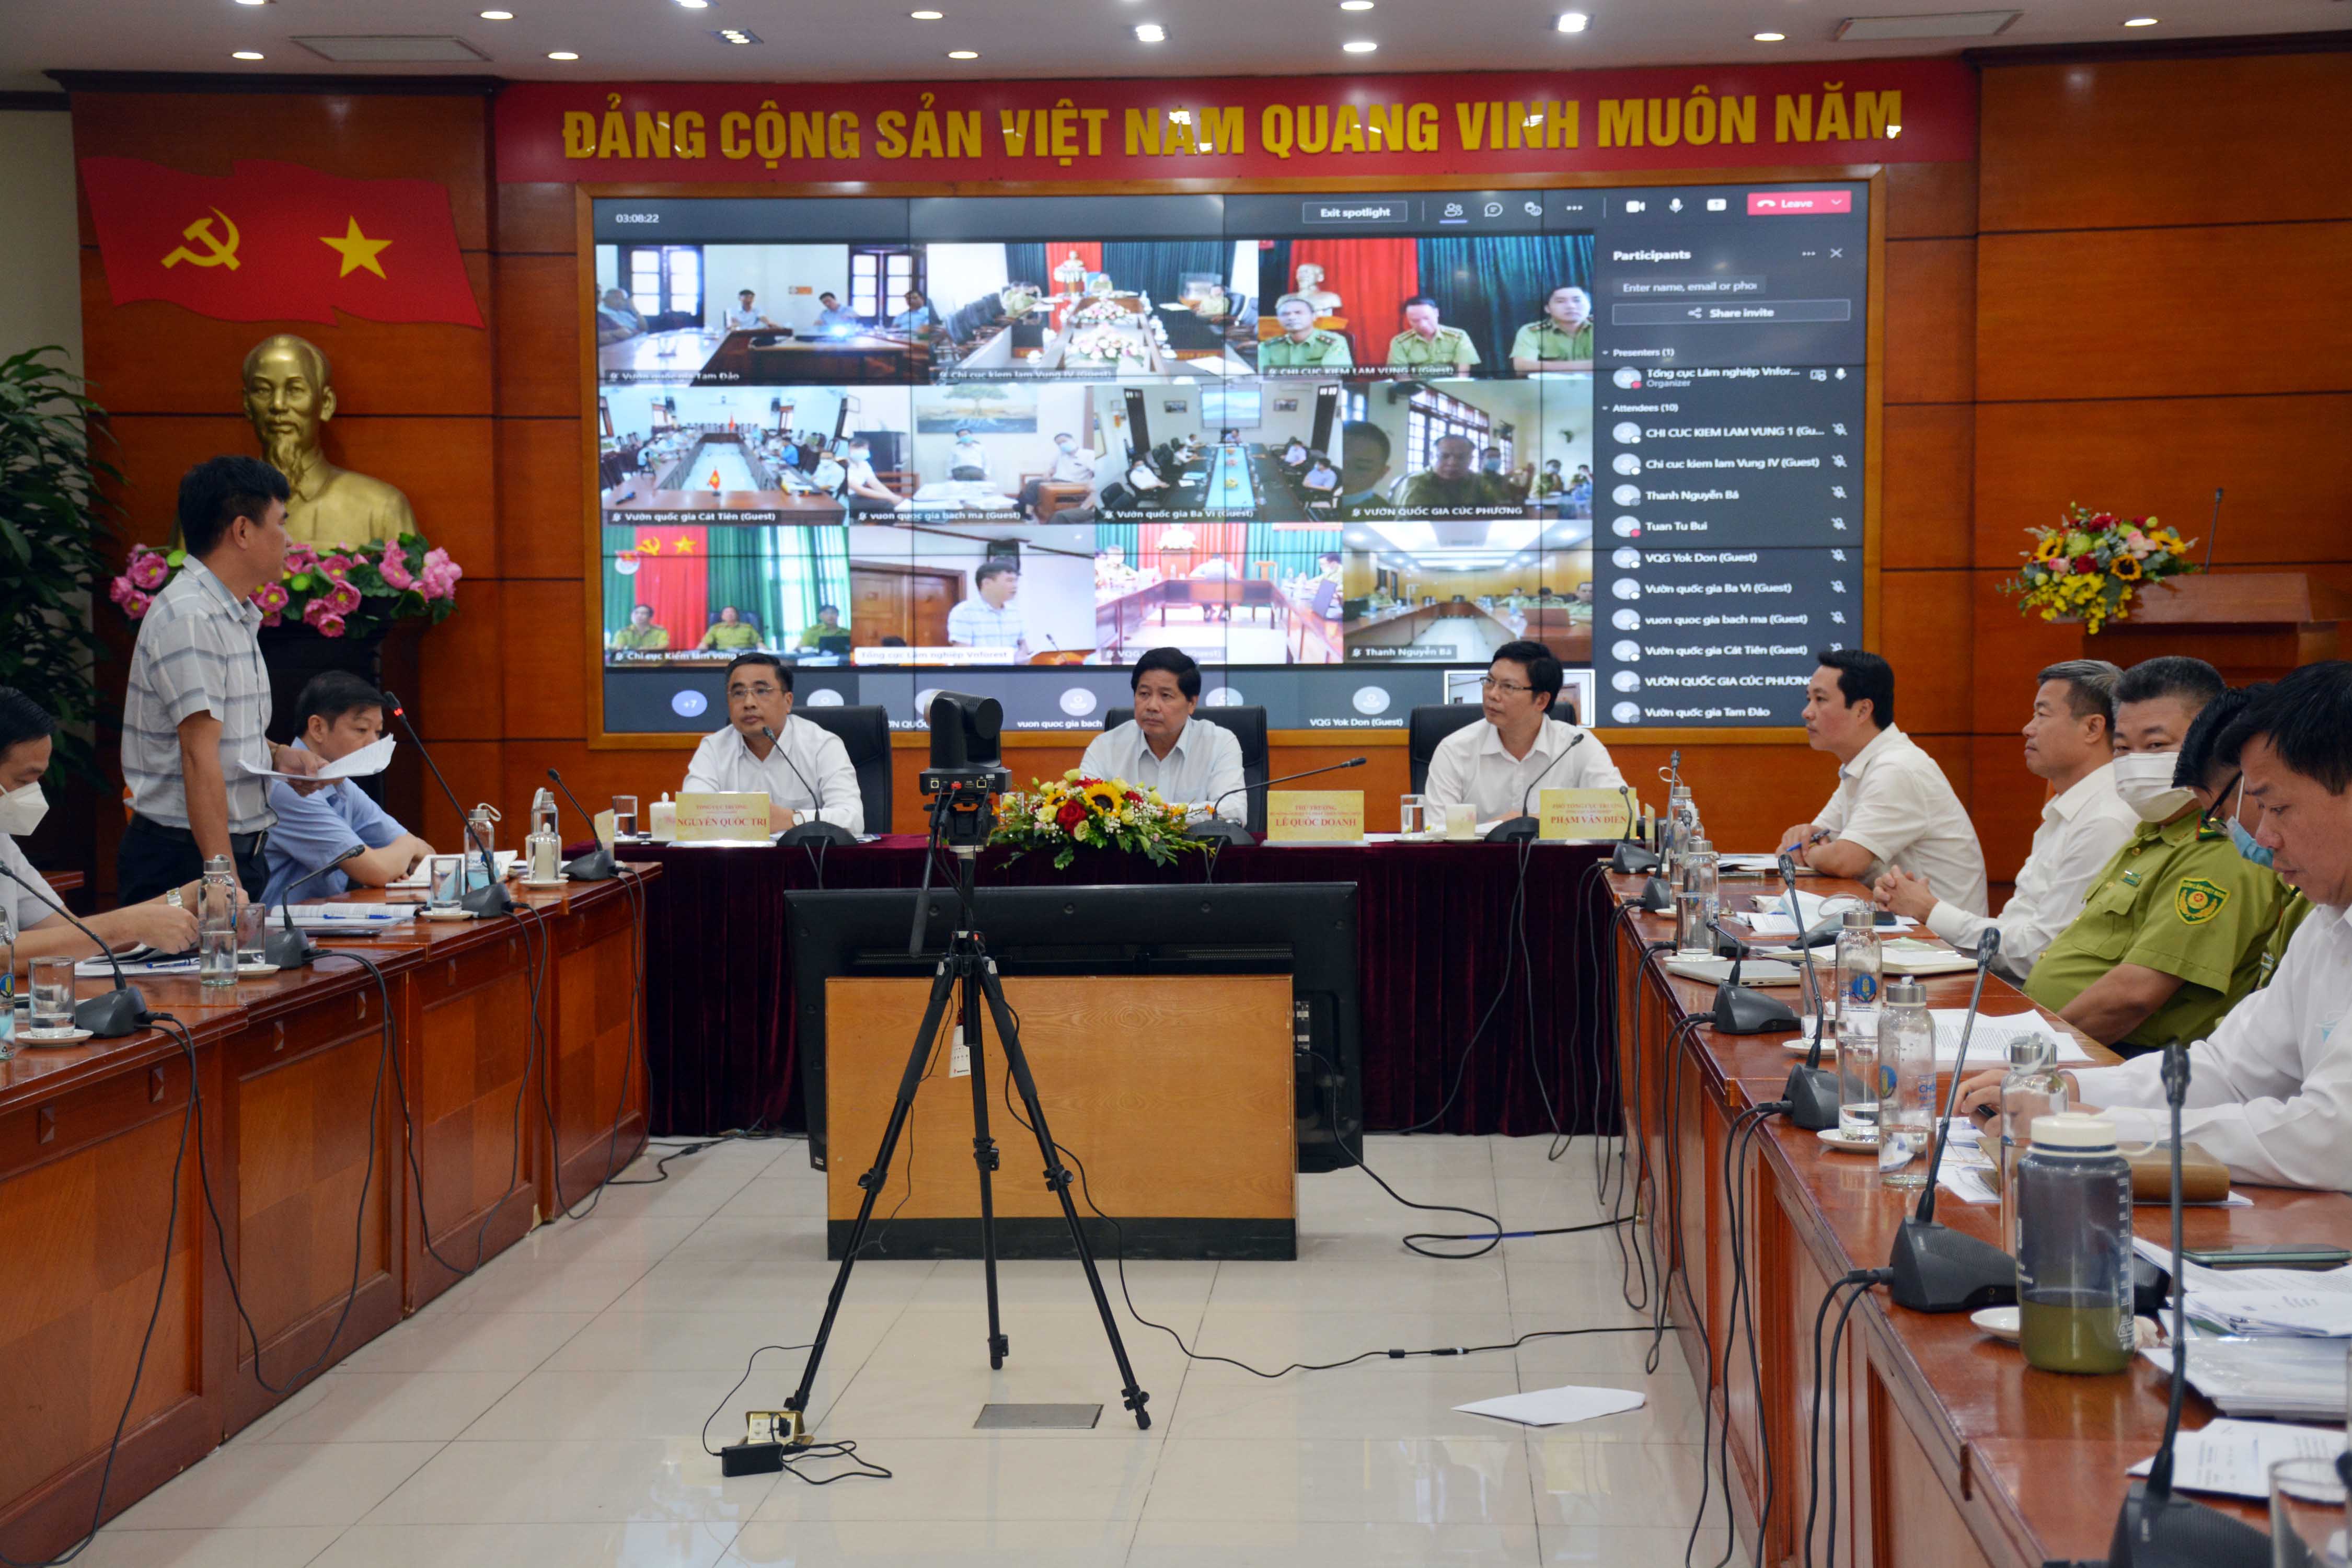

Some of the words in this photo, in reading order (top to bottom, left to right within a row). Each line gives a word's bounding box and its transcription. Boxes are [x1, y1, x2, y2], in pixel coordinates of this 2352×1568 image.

[562, 92, 706, 159] ĐẢNG
[720, 100, 860, 169] CỘNG
[875, 92, 982, 158] SẢN
[1000, 98, 1109, 166] VIỆT
[1125, 106, 1245, 156] NAM
[1262, 102, 1438, 158] QUANG
[1456, 100, 1579, 150] VINH
[1598, 85, 1757, 148] MUÔN
[1775, 82, 1902, 143] NĂM
[1781, 199, 1812, 209] Leave
[1320, 208, 1340, 217] Exit
[1343, 207, 1390, 219] spotlight
[616, 214, 660, 224] 03:08:22
[1613, 250, 1691, 262] Participants
[1623, 283, 1651, 292] Enter
[1653, 284, 1685, 293] name,
[1688, 282, 1716, 291] email
[1710, 309, 1741, 318] Share
[1743, 308, 1774, 317] invite
[1613, 348, 1660, 356] Presenters
[1662, 348, 1675, 357] (1)
[697, 372, 717, 381] Tam
[719, 370, 739, 381] Đảo
[1646, 369, 1675, 379] Tổng
[1677, 370, 1695, 379] cục
[1697, 367, 1720, 378] Lâm
[1722, 367, 1759, 378] nghiệp
[1646, 379, 1691, 388] Organizer
[1612, 404, 1658, 412] Attendees
[1661, 403, 1678, 413] (10)
[1645, 429, 1666, 437] CHI
[1668, 428, 1692, 437] CUC
[1694, 428, 1722, 437] KIEM
[1724, 428, 1747, 436] LAM
[1750, 427, 1786, 436] VUNG
[1645, 460, 1664, 468] Chi
[1688, 459, 1713, 468] kiem
[1715, 459, 1735, 468] lam
[1737, 459, 1766, 470] Vung
[1768, 458, 1780, 468] IV
[1781, 457, 1819, 468] (Guest)
[1645, 491, 1678, 500] Thanh
[1681, 490, 1723, 502] Nguyễn
[897, 512, 920, 522] quoc
[925, 512, 941, 521] gia
[942, 511, 966, 520] bach
[986, 511, 1021, 520] (Guest)
[1117, 510, 1144, 518] Vườn
[1146, 509, 1170, 521] quốc
[1172, 510, 1188, 521] gia
[1190, 510, 1203, 518] Ba
[1218, 509, 1253, 519] (Guest)
[1364, 507, 1396, 516] VƯỜN
[1398, 505, 1428, 517] QUỐC
[1475, 505, 1522, 515] PHƯƠNG
[654, 512, 678, 522] quốc
[681, 513, 696, 522] gia
[698, 512, 716, 521] Cát
[718, 512, 738, 521] Tiên
[741, 512, 776, 522] (Guest)
[1645, 522, 1672, 531] Tuan
[1674, 522, 1688, 531] Tu
[1690, 522, 1708, 531] Bui
[1645, 554, 1670, 563] VQG
[1673, 553, 1692, 562] Yok
[1694, 554, 1717, 562] Don
[1719, 552, 1757, 563] (Guest)
[1645, 584, 1674, 593] Vườn
[1677, 583, 1703, 595] quốc
[1705, 584, 1723, 595] gia
[1725, 584, 1738, 593] Ba
[1754, 583, 1792, 594] (Guest)
[1674, 616, 1701, 627] quoc
[1703, 615, 1720, 626] gia
[1722, 615, 1749, 624] bach
[1769, 614, 1808, 625] (Guest)
[1365, 648, 1396, 656] Thanh
[1398, 646, 1437, 658] Nguyễn
[1645, 646, 1674, 656] Vườn
[1676, 645, 1703, 658] quốc
[1705, 646, 1722, 657] gia
[1724, 645, 1743, 655] Cát
[1744, 645, 1768, 655] Tiên
[1769, 645, 1808, 656] (Guest)
[1645, 676, 1679, 686] VƯỜN
[1681, 675, 1715, 687] QUỐC
[1717, 677, 1737, 686] GIA
[683, 699, 697, 708] +7
[1645, 708, 1674, 717] Vườn
[1676, 707, 1703, 719] quốc
[1705, 707, 1722, 719] gia
[1724, 708, 1746, 717] Tam
[1747, 706, 1770, 717] Đảo
[1041, 721, 1064, 730] quoc
[1065, 720, 1079, 729] gia
[1081, 719, 1102, 728] bach
[1309, 719, 1331, 728] VQG
[1371, 718, 1403, 727] (Guest)
[677, 816, 717, 826] NGUYỄN
[720, 816, 746, 827] QUỐC
[752, 818, 767, 828] TRỊ
[1290, 816, 1318, 827] QUỐC
[1551, 816, 1579, 825] PHẠM
[1582, 814, 1601, 823] VĂN
